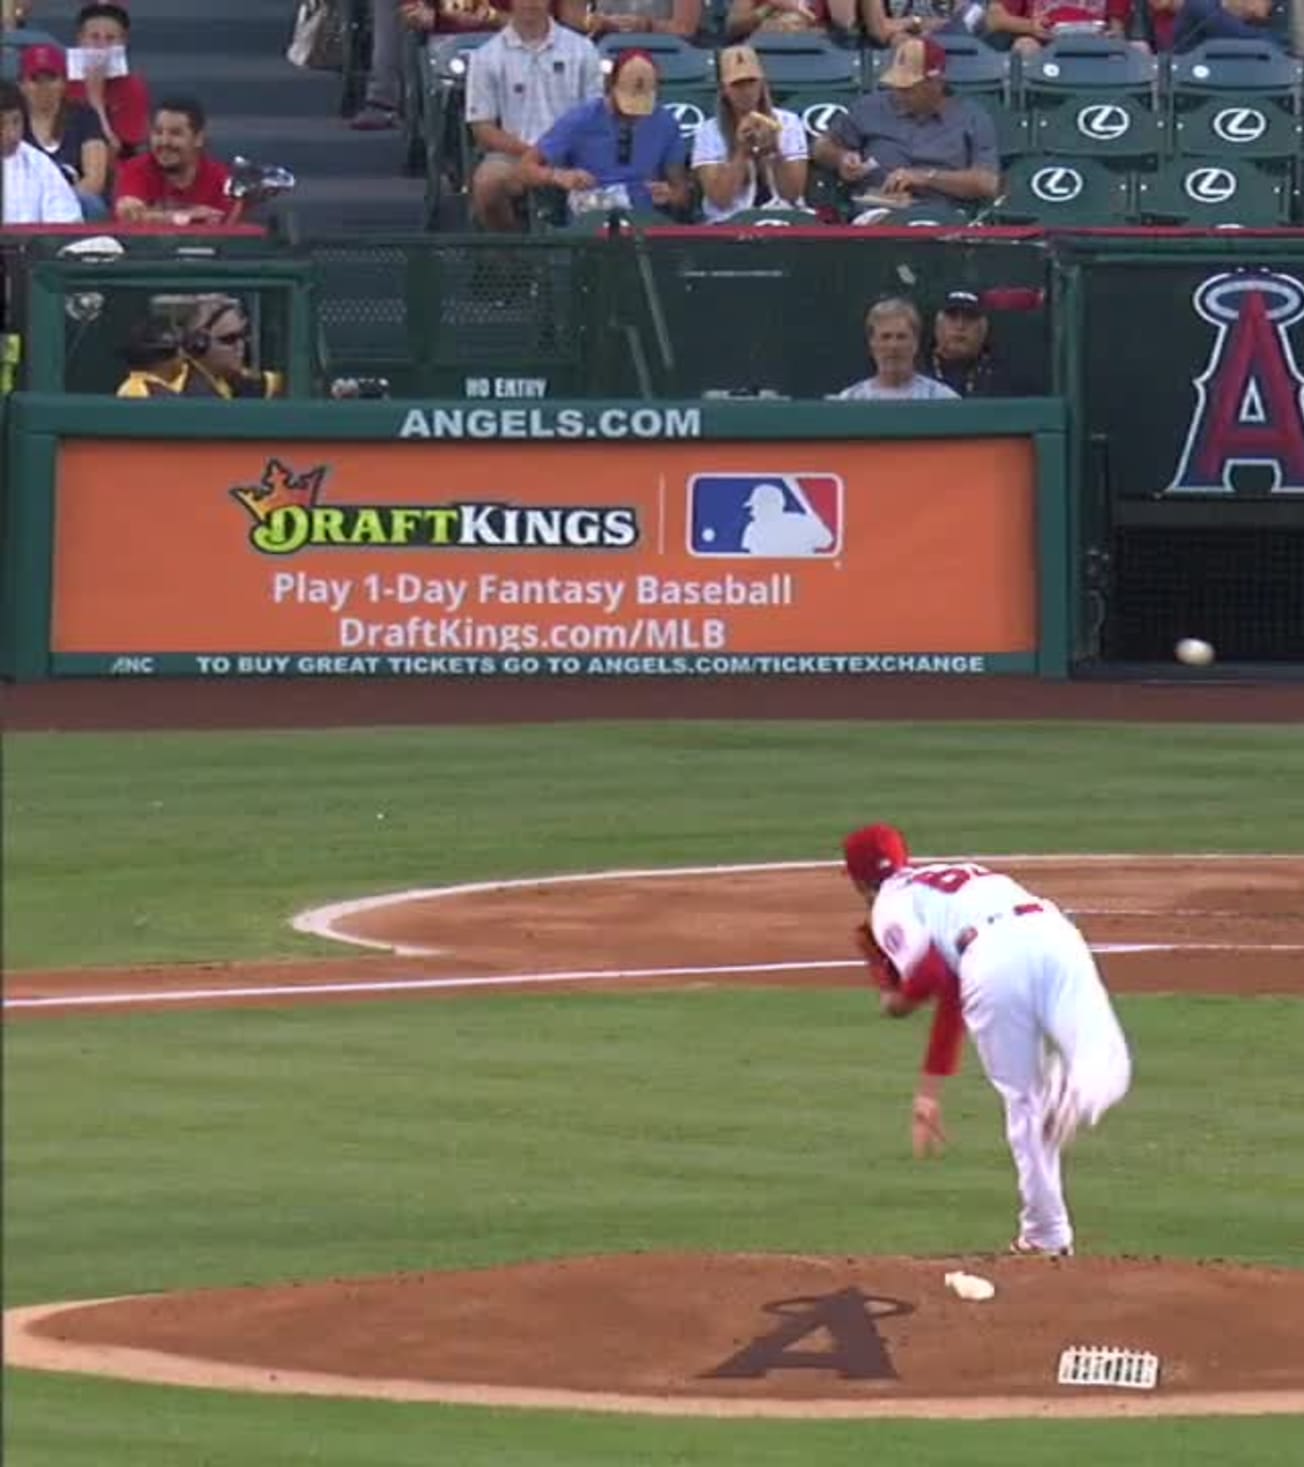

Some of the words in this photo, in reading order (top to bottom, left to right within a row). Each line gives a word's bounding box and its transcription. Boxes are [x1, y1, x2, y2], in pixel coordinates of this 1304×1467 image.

[494, 376, 548, 397] ENTRY
[400, 408, 701, 438] ANGELS.COM
[273, 572, 352, 612] Play
[364, 573, 466, 612] 1-Day
[479, 574, 625, 613] Fantasy
[637, 573, 792, 605] Baseball
[339, 617, 726, 653] DraftKings.com/MLB
[197, 656, 230, 674] TO
[238, 656, 291, 673] BUY
[298, 656, 378, 673] GREAT
[387, 656, 497, 673] TICKETS
[503, 656, 540, 673] GO
[547, 656, 581, 673] TO
[588, 655, 985, 673] ANGELS.COM/TICKETEXCHANGE
